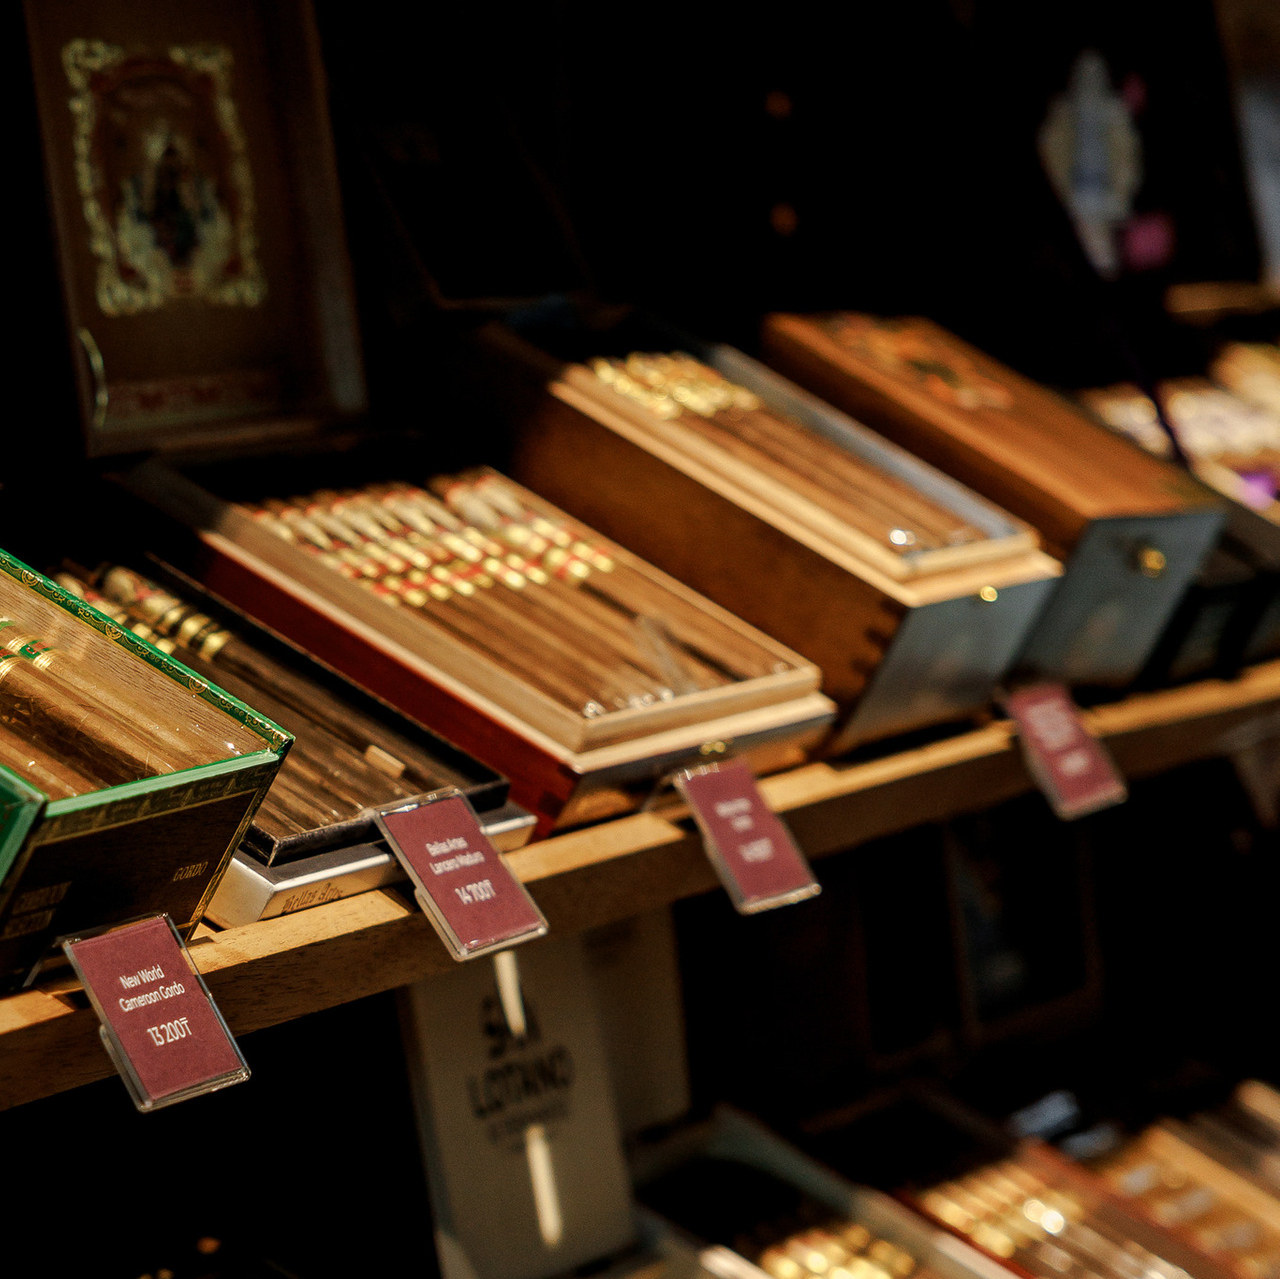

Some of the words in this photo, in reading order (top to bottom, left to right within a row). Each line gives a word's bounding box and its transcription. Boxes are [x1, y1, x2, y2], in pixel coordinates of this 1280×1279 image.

[172, 861, 209, 883] GORDO
[280, 889, 318, 916] Bellas
[119, 975, 141, 990] New
[138, 964, 165, 984] World
[119, 990, 162, 1012] Cameroon
[159, 981, 185, 999] Gordo
[147, 1026, 165, 1047] 13
